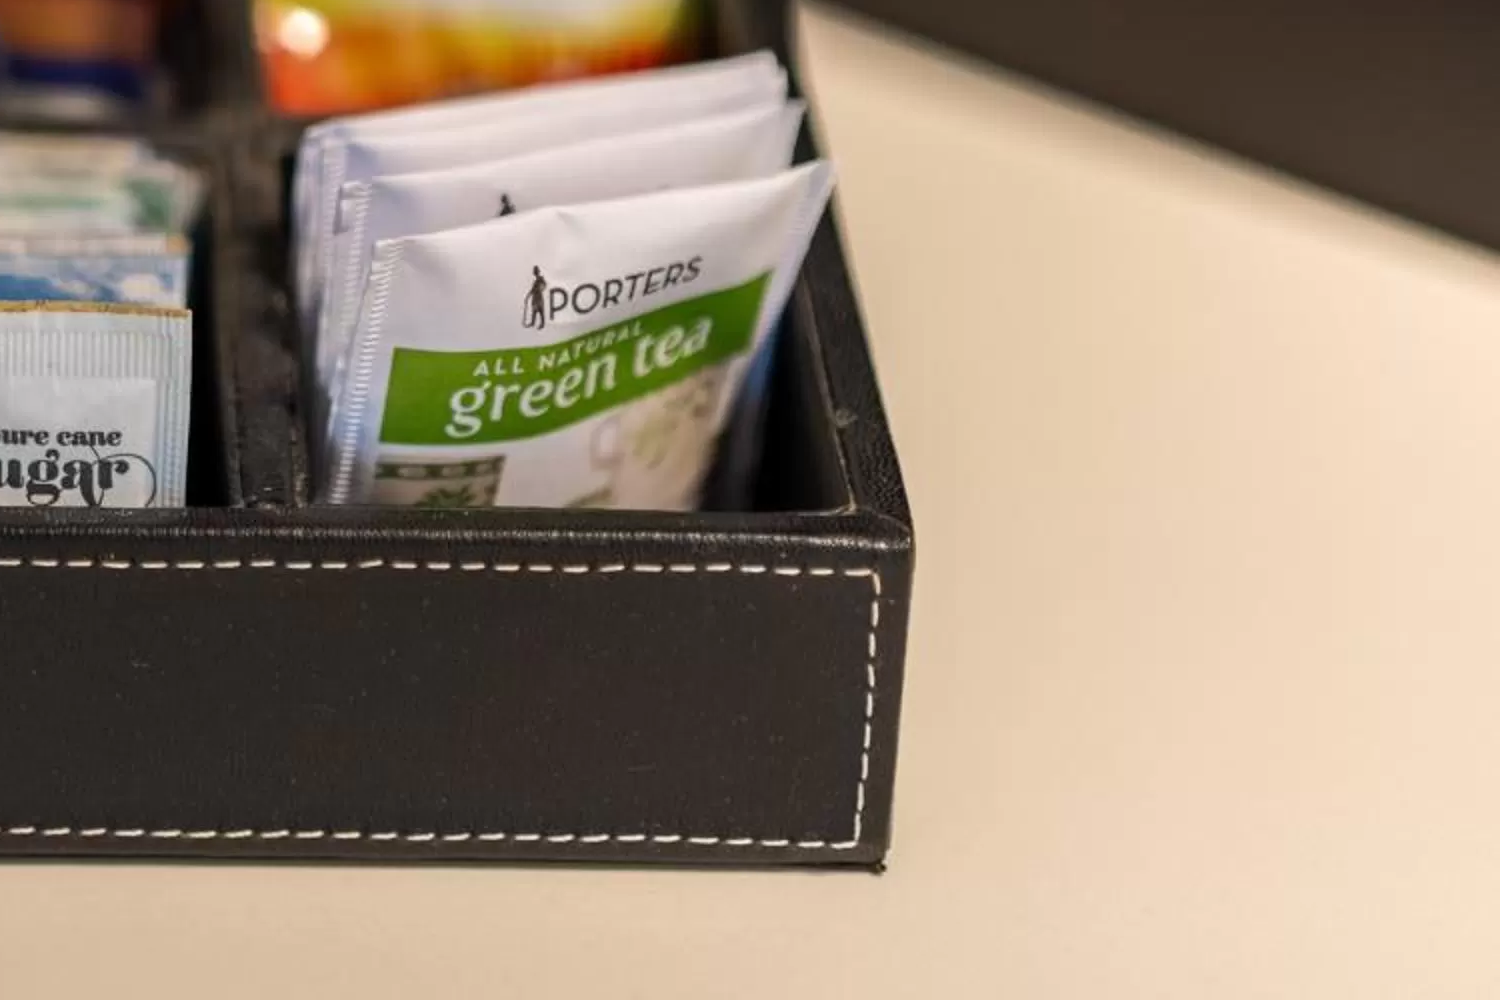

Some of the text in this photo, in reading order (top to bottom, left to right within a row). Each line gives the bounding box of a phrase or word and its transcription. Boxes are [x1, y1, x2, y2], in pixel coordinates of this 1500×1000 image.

[550, 256, 703, 321] PORTERS
[444, 317, 713, 439] green tea
[473, 318, 645, 378] ALL NATURAL
[55, 429, 123, 449] cane
